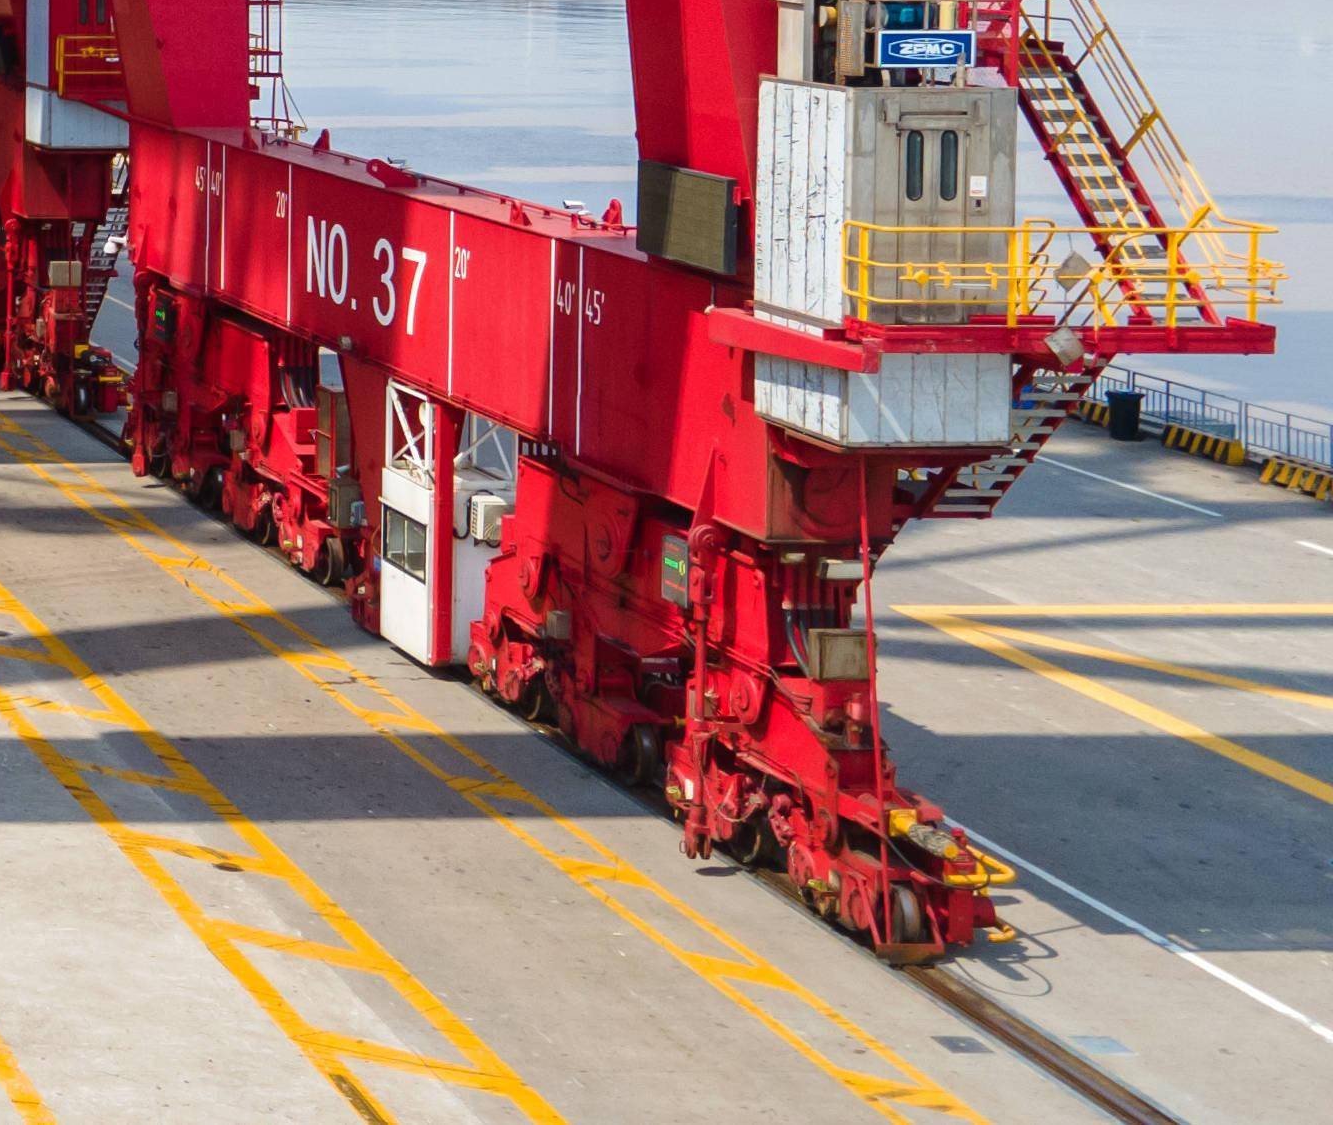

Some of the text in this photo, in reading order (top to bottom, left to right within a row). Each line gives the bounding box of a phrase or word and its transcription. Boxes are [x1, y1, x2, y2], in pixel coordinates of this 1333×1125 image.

[899, 43, 955, 55] ZPMC
[195, 166, 206, 193] 45'
[210, 171, 222, 196] 40'
[275, 190, 288, 218] 20'
[306, 215, 428, 336] NO. 37
[454, 246, 472, 280] 20'
[556, 279, 575, 316] 40'
[585, 288, 606, 325] 45'
